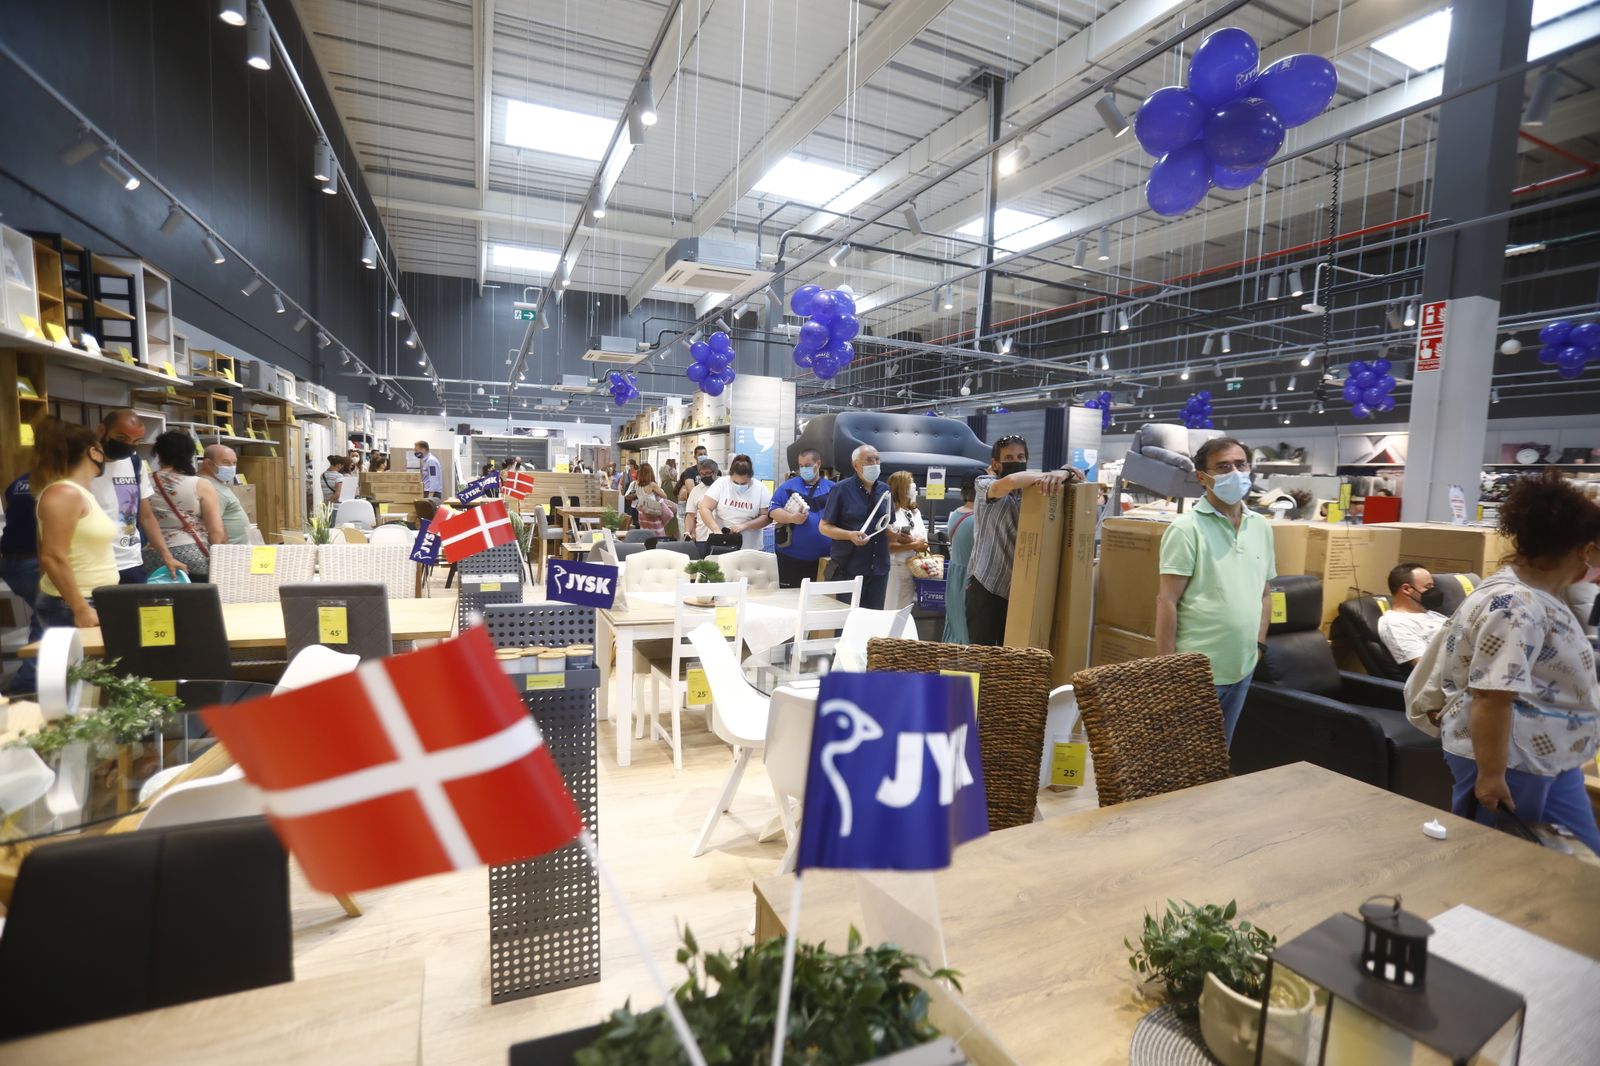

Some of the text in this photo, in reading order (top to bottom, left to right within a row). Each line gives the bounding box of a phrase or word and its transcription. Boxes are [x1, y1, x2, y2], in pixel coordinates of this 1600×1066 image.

[465, 487, 481, 499] JYSK
[420, 532, 436, 554] JYS
[565, 573, 611, 595] JYSK
